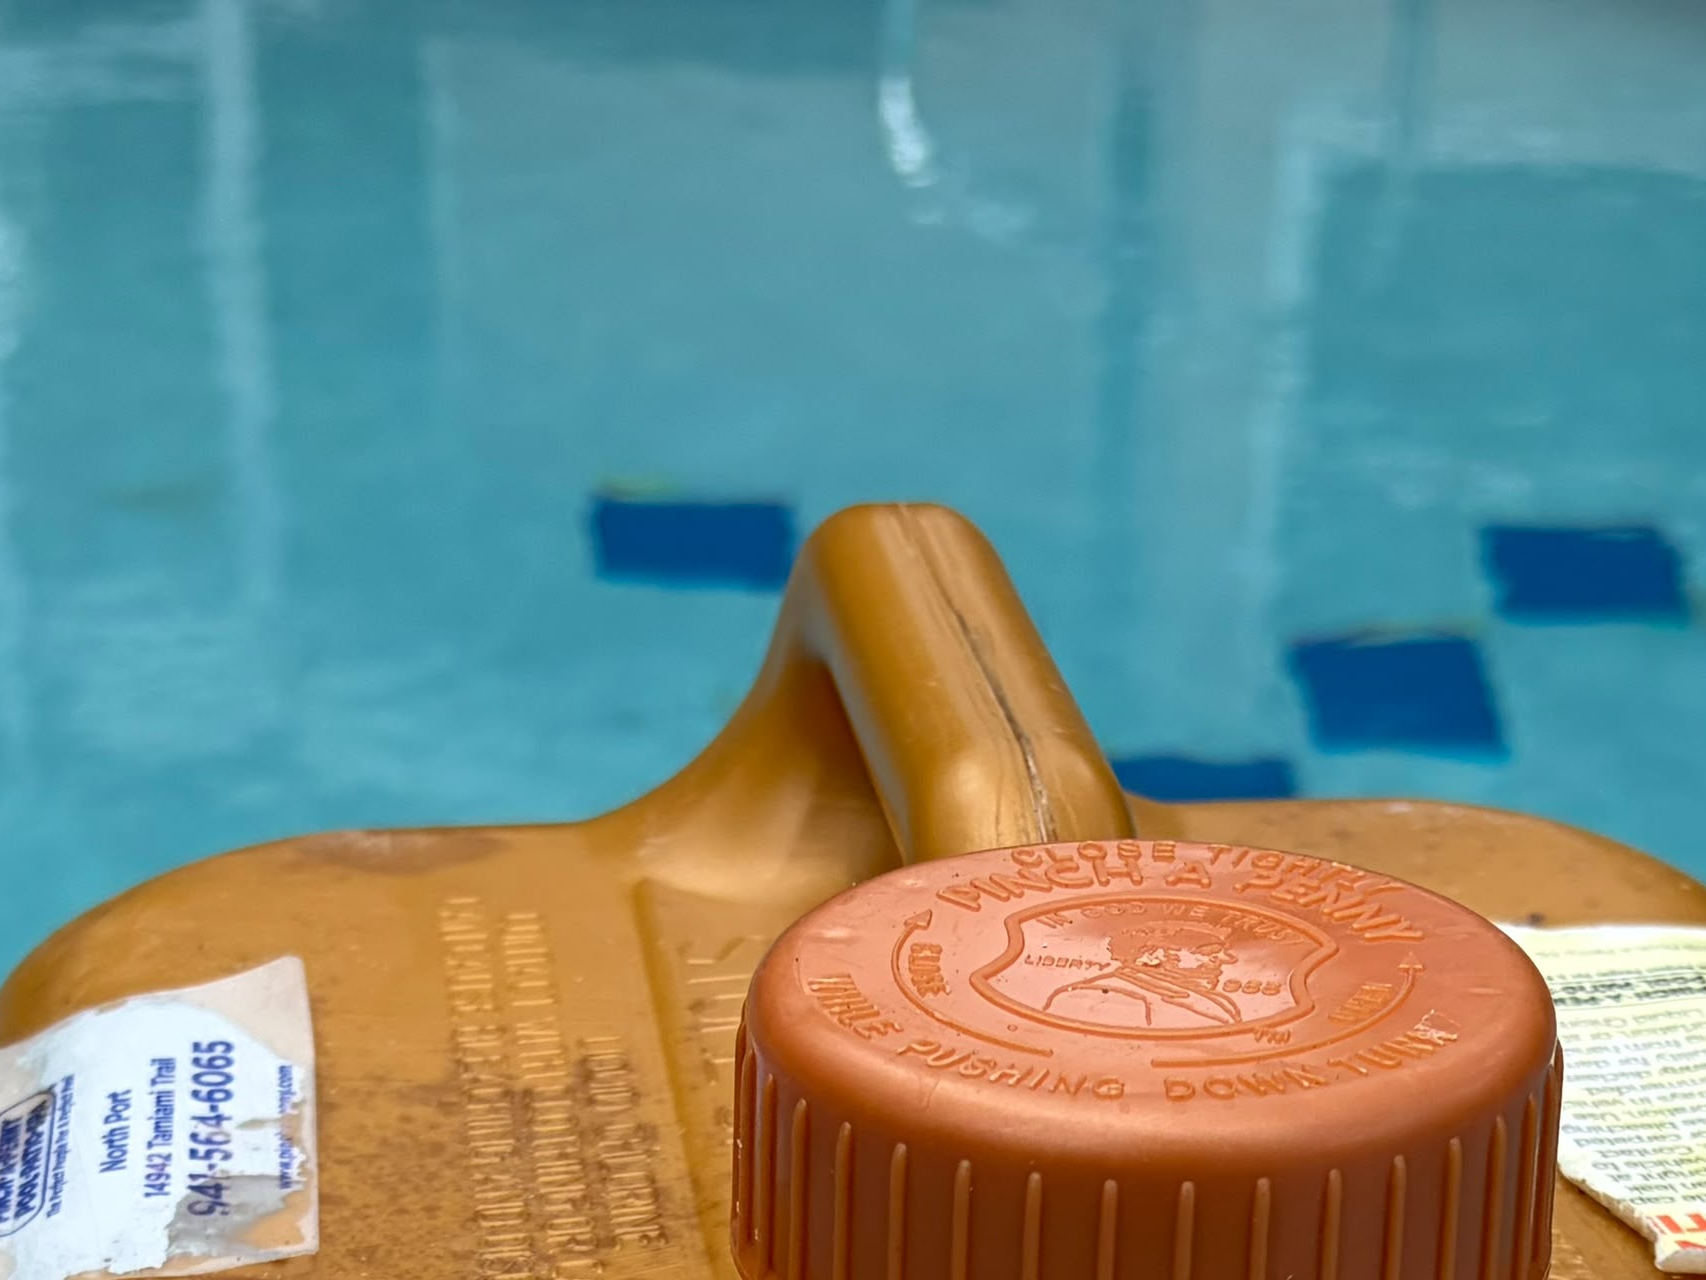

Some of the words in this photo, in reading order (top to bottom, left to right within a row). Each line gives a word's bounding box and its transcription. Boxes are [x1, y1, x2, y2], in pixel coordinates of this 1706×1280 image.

[1011, 840, 1176, 868] CLOSE
[935, 856, 1144, 912] PINCH
[1165, 861, 1212, 890] A
[1233, 873, 1424, 943] PENNY
[1161, 903, 1210, 918] WE
[807, 974, 904, 1040] WHILE
[895, 1039, 1126, 1099] PUSHING
[1163, 1064, 1330, 1101] DOWN
[149, 1057, 176, 1088] Trail
[103, 1088, 133, 1125] Port
[1630, 1098, 1651, 1107] in
[146, 1091, 175, 1150] Tamiami
[1572, 1112, 1619, 1121] Use
[187, 1040, 235, 1216] 941-564-6065
[1561, 1122, 1678, 1136] bleaching
[98, 1126, 131, 1173] North
[1574, 1133, 1682, 1148] carpeted
[1596, 1146, 1693, 1159] Contact
[143, 1152, 172, 1198] 14942
[1592, 1162, 1619, 1171] to
[1609, 1173, 1632, 1182] at
[48, 1172, 69, 1200] Perfect
[1625, 1182, 1676, 1194] leak
[46, 1201, 63, 1218] The
